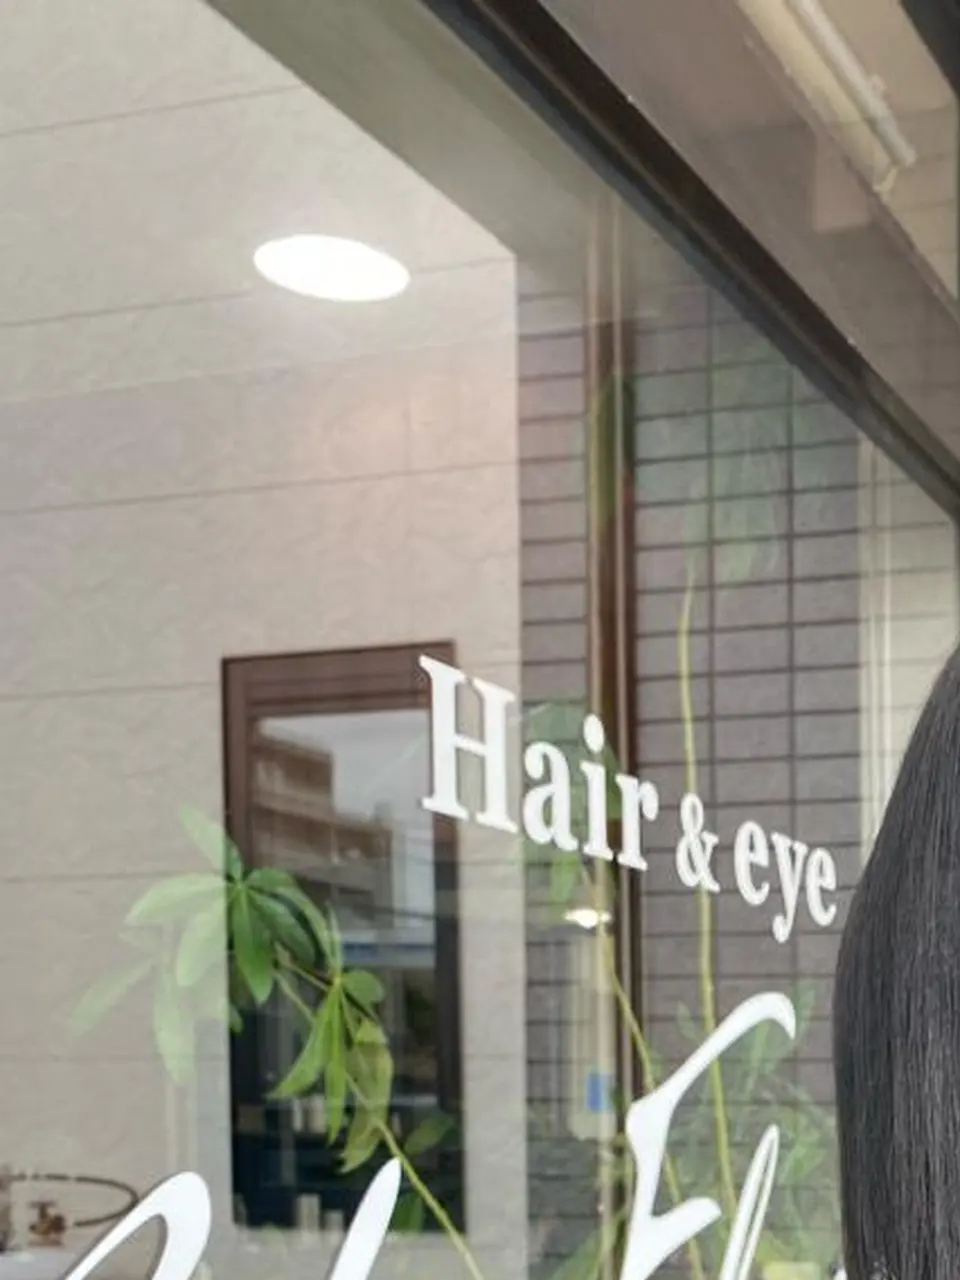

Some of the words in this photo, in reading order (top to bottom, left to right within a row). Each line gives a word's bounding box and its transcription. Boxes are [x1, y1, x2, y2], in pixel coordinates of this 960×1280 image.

[419, 654, 659, 871] Hair
[676, 792, 720, 893] &
[734, 820, 837, 943] eye
